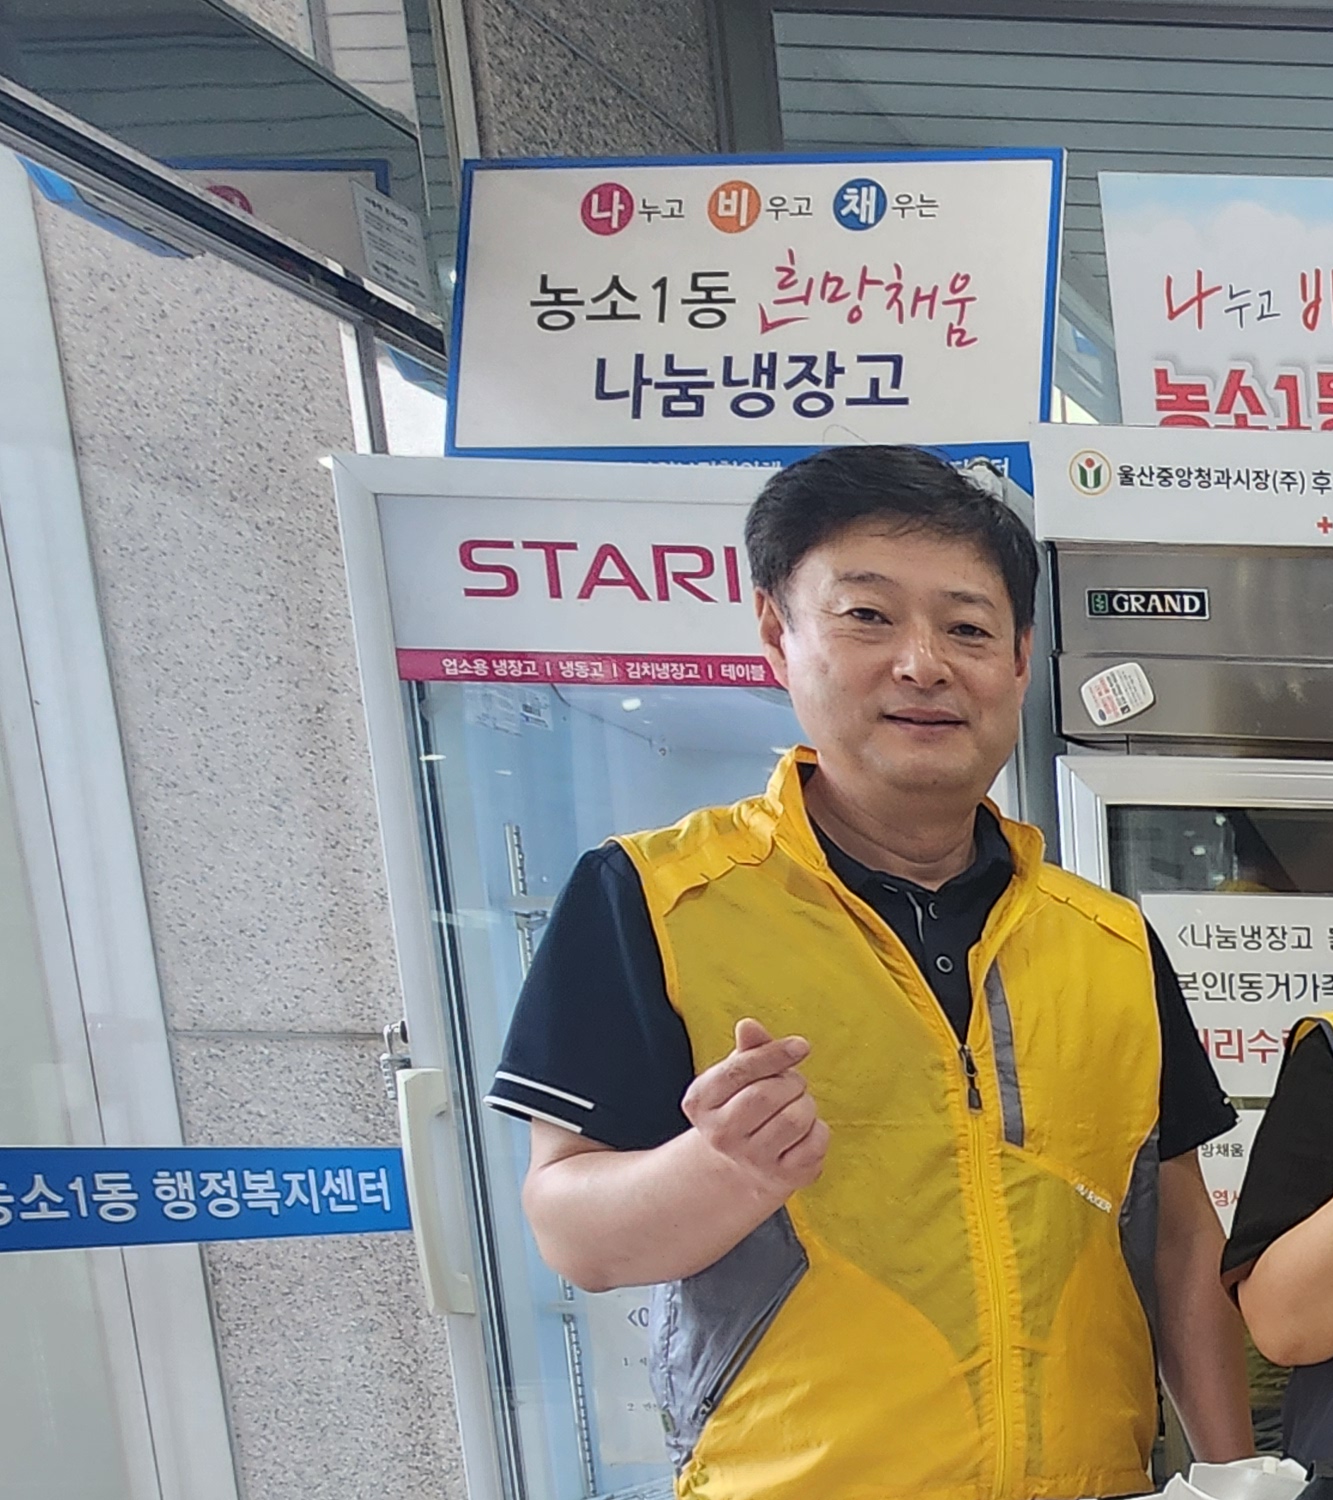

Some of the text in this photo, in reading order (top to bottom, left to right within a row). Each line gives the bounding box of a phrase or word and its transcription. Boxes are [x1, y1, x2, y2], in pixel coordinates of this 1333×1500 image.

[587, 182, 940, 231] 나누고 비우고 채우는
[529, 249, 979, 349] 농소1동 희망채움
[1164, 268, 1283, 331] 나누고
[594, 352, 910, 420] 나눔냉장고
[1115, 462, 1306, 497] 울산중앙청과시장(주)
[458, 538, 743, 603] STARI
[1112, 591, 1201, 615] GRAND
[442, 657, 766, 682] 업소용 냉장고 냉동고 김치냉장고 테이블
[152, 1166, 392, 1222] 행정복지센터
